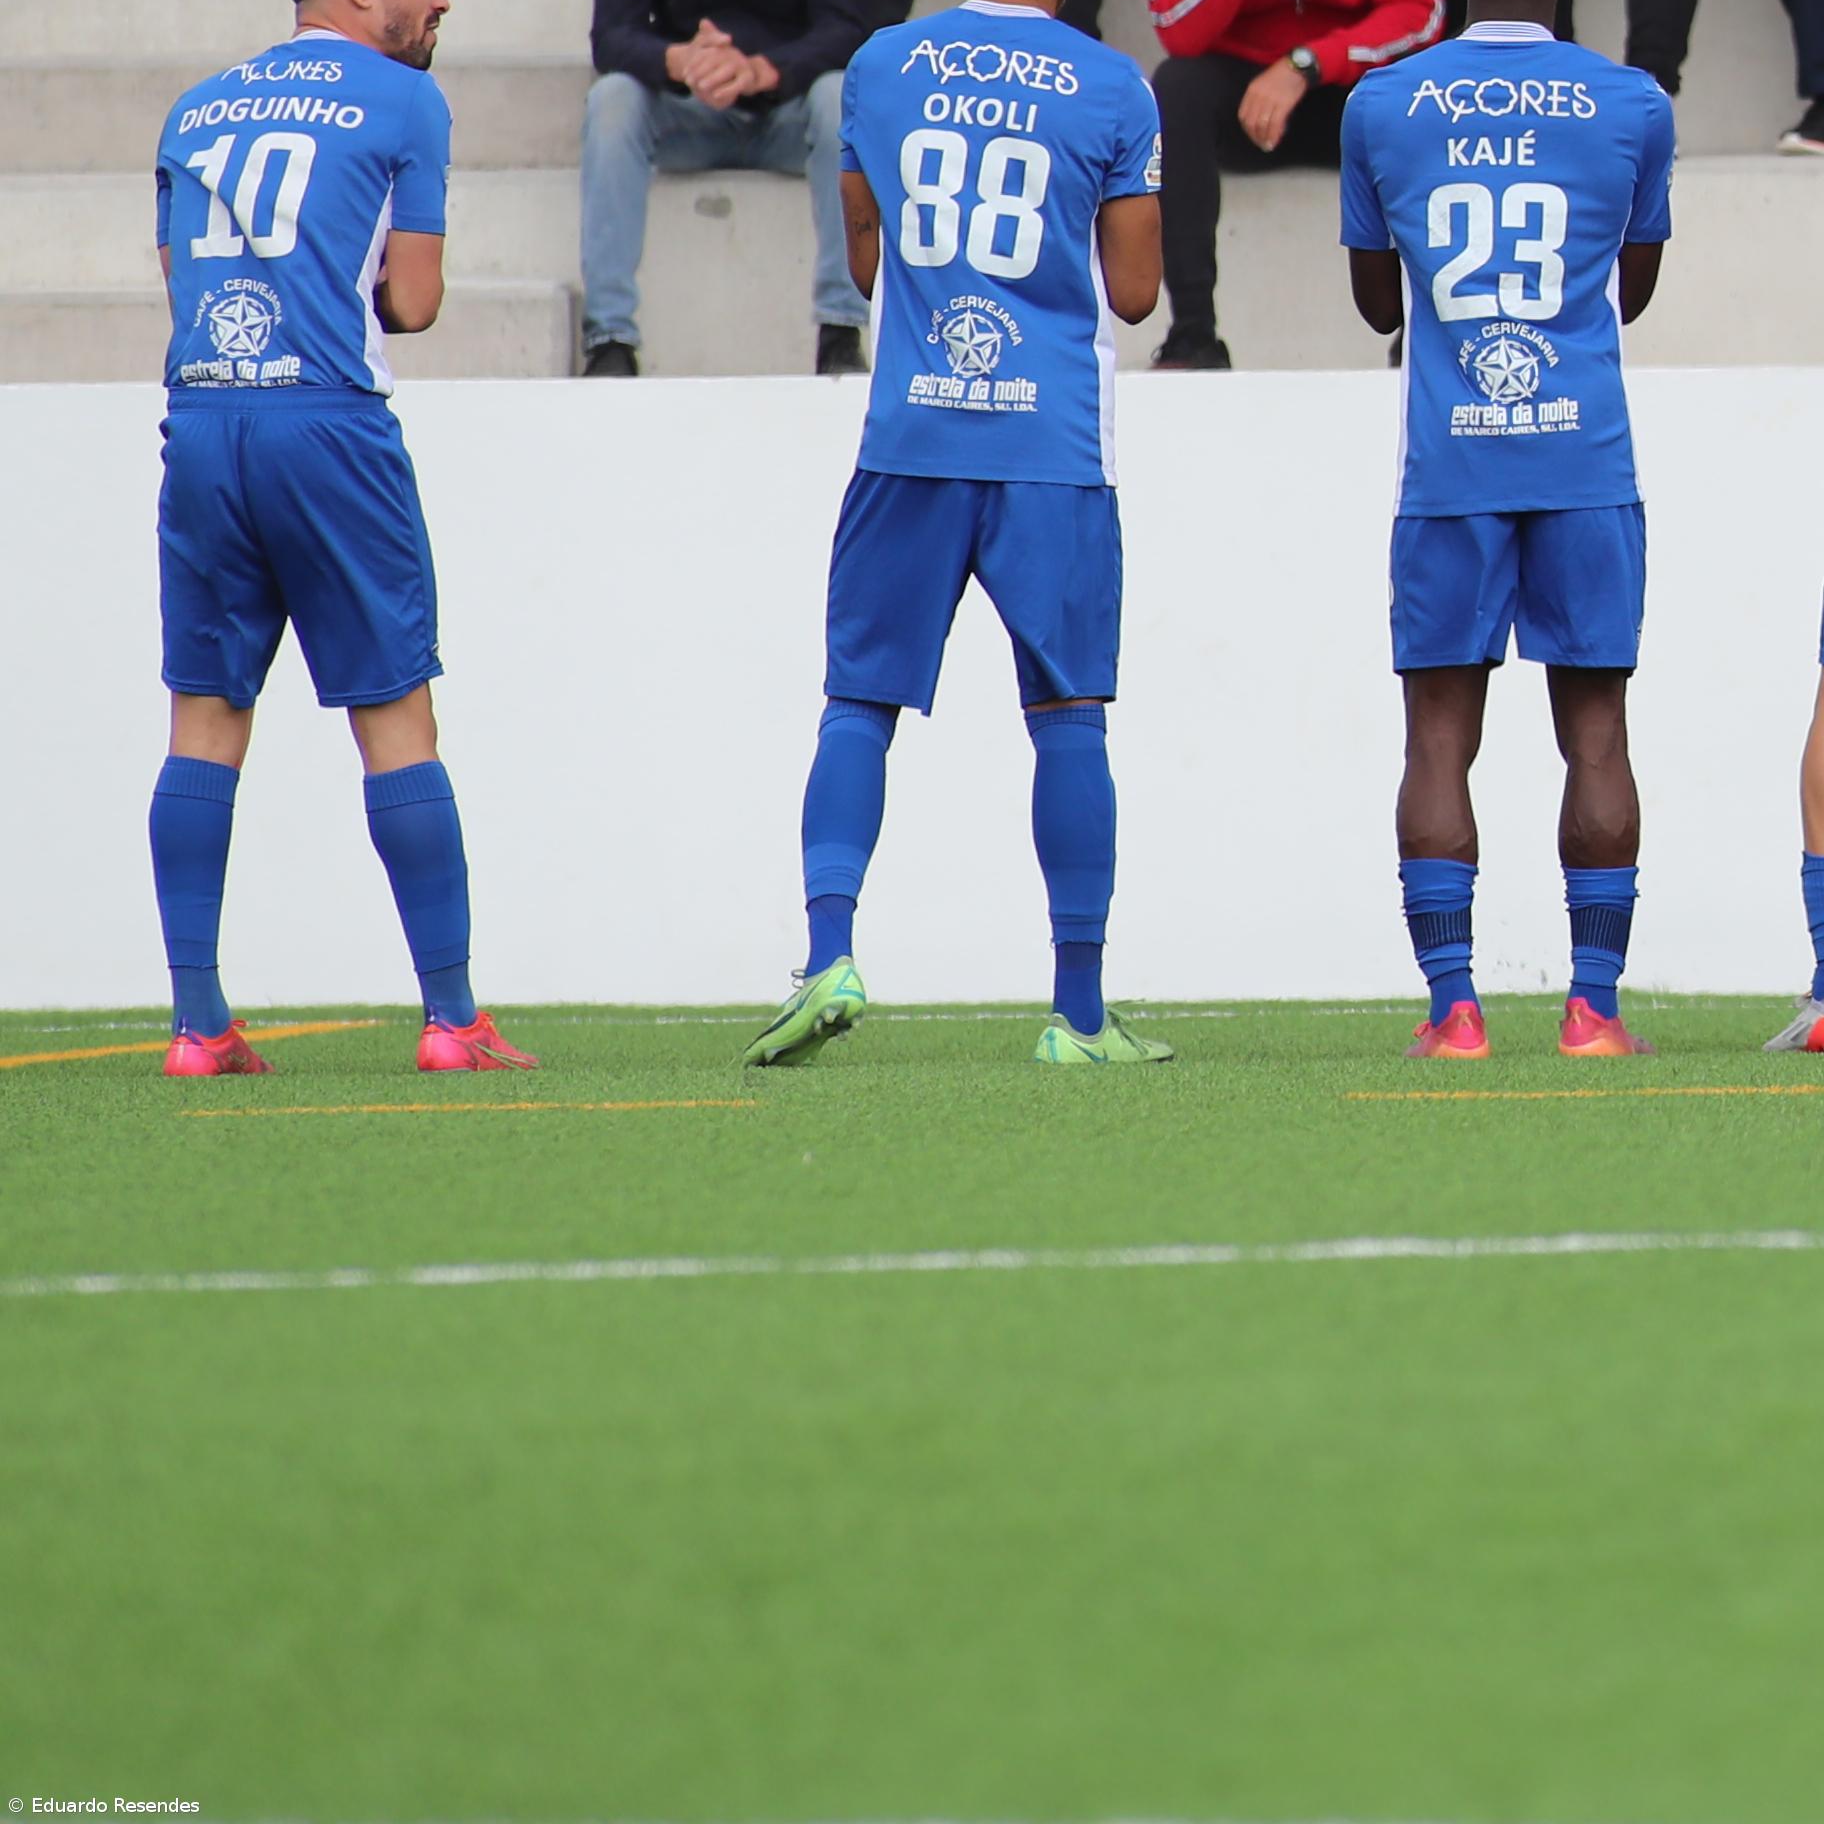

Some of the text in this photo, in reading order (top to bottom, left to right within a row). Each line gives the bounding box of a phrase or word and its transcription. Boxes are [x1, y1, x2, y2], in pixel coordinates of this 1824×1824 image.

[901, 39, 1079, 96] AÇORES
[178, 96, 364, 135] DIOGUINHO
[922, 93, 1038, 133] OKOLI
[1407, 78, 1597, 124] AÇORES
[1447, 129, 1536, 167] KAJÉ
[186, 132, 316, 259] 10
[900, 128, 1050, 280] 88
[1427, 182, 1569, 322] 23
[949, 295, 1023, 347] CERVEJARIA
[237, 358, 258, 380] da
[260, 355, 300, 379] noite
[1481, 322, 1560, 368] CERVEJARIA
[909, 373, 1037, 402] estrela da noite
[1451, 397, 1579, 426] estrela da noite
